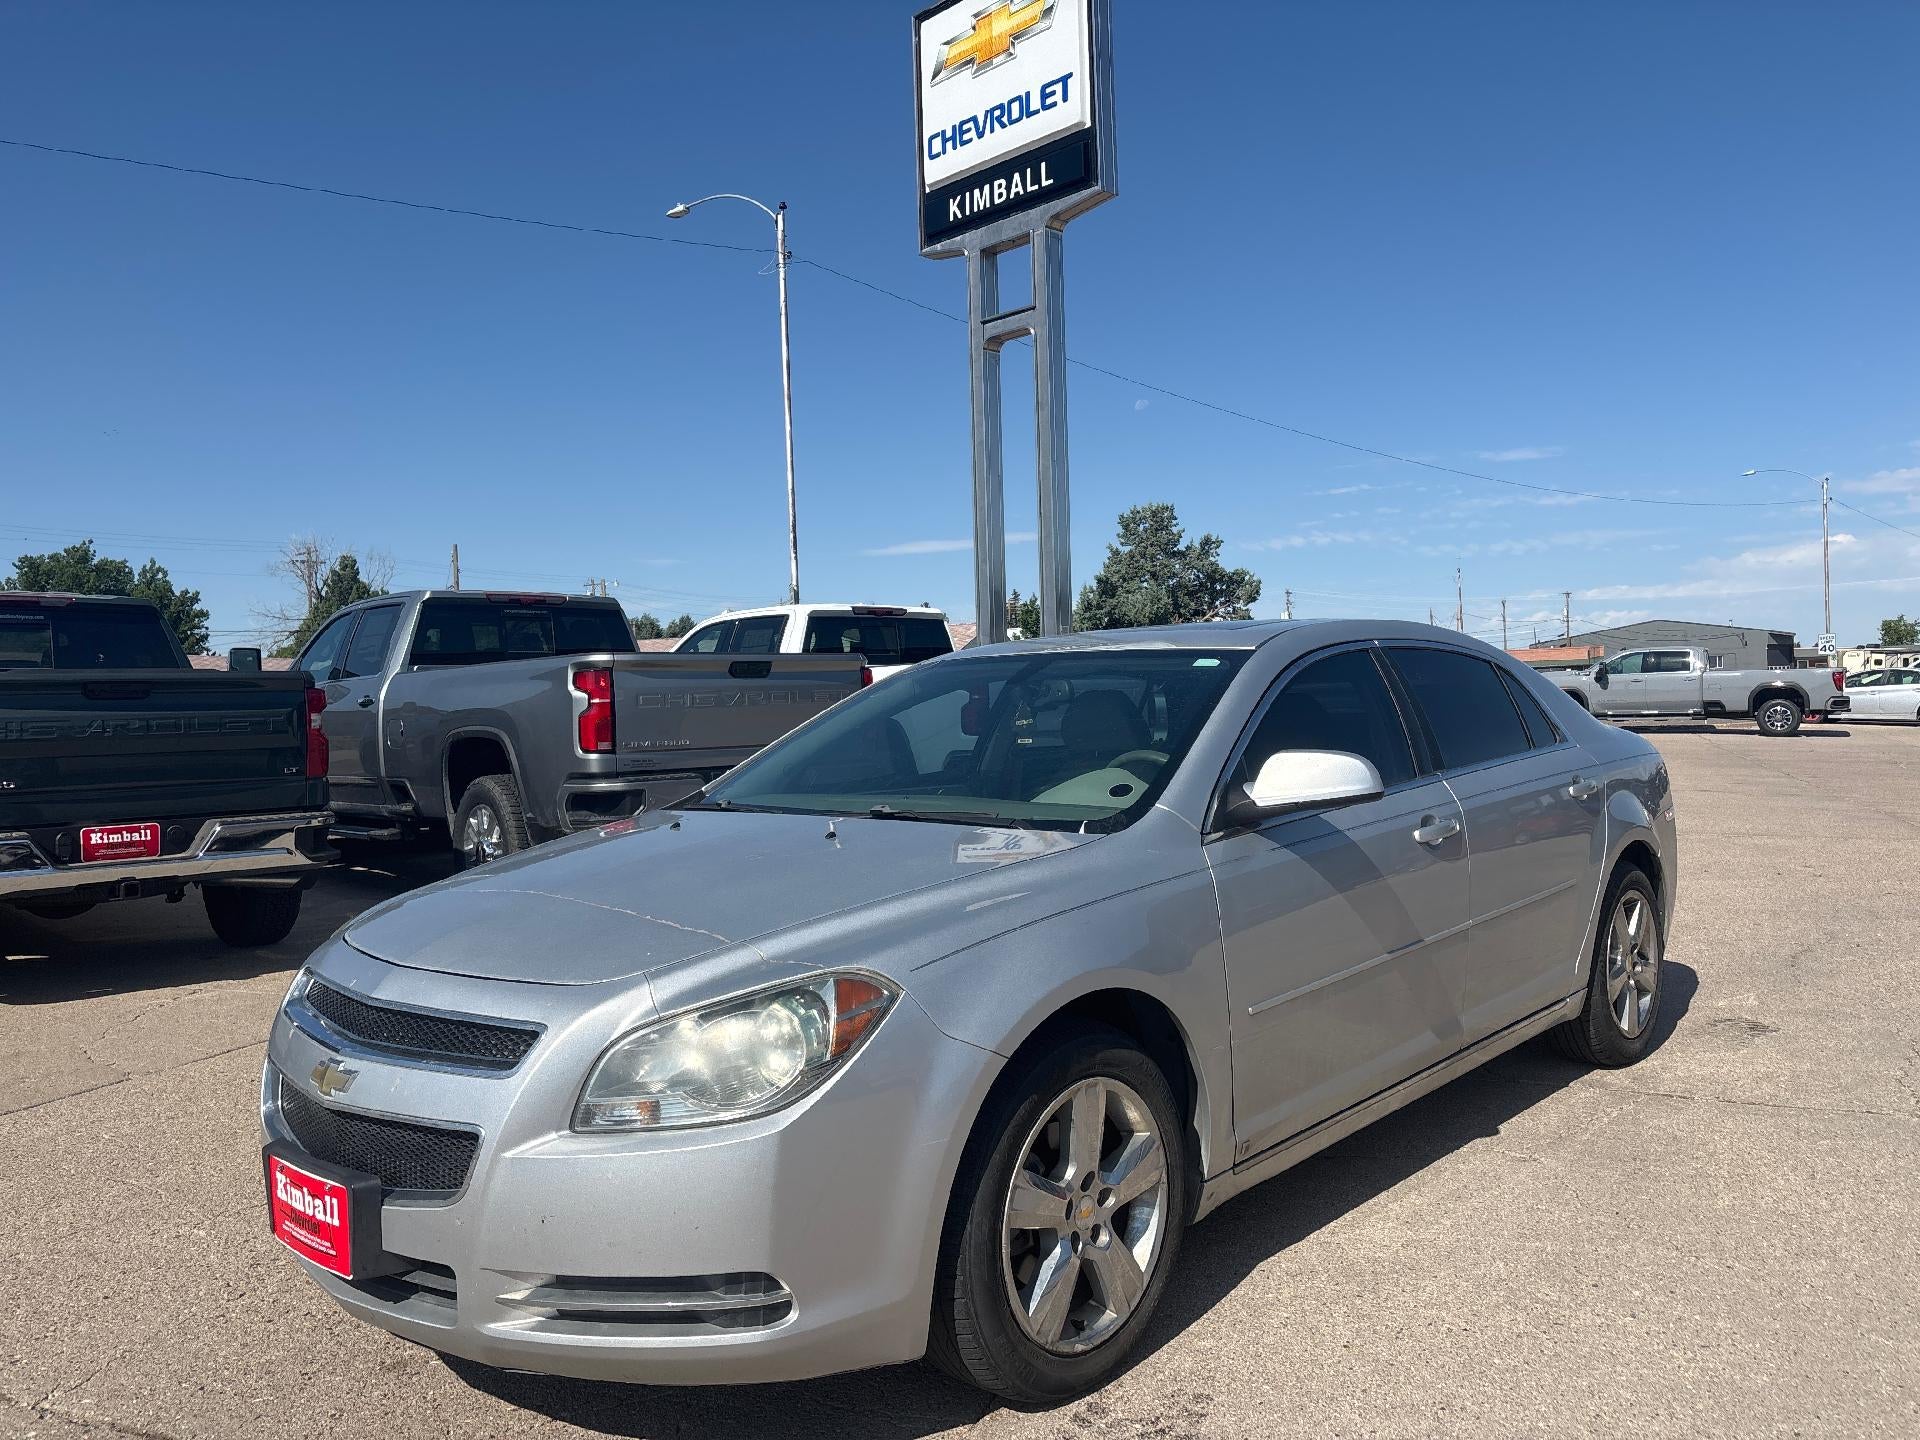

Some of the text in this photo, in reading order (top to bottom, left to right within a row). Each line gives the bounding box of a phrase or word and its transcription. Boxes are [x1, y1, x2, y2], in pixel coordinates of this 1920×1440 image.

[928, 71, 1073, 161] CHEVROLET
[949, 162, 1054, 221] KIMBALL
[1820, 644, 1834, 652] 40
[636, 689, 850, 709] CHEVROLET
[90, 829, 151, 844] Kimball
[276, 1171, 340, 1227] Kimball
[290, 1207, 320, 1235] Chevrolet
